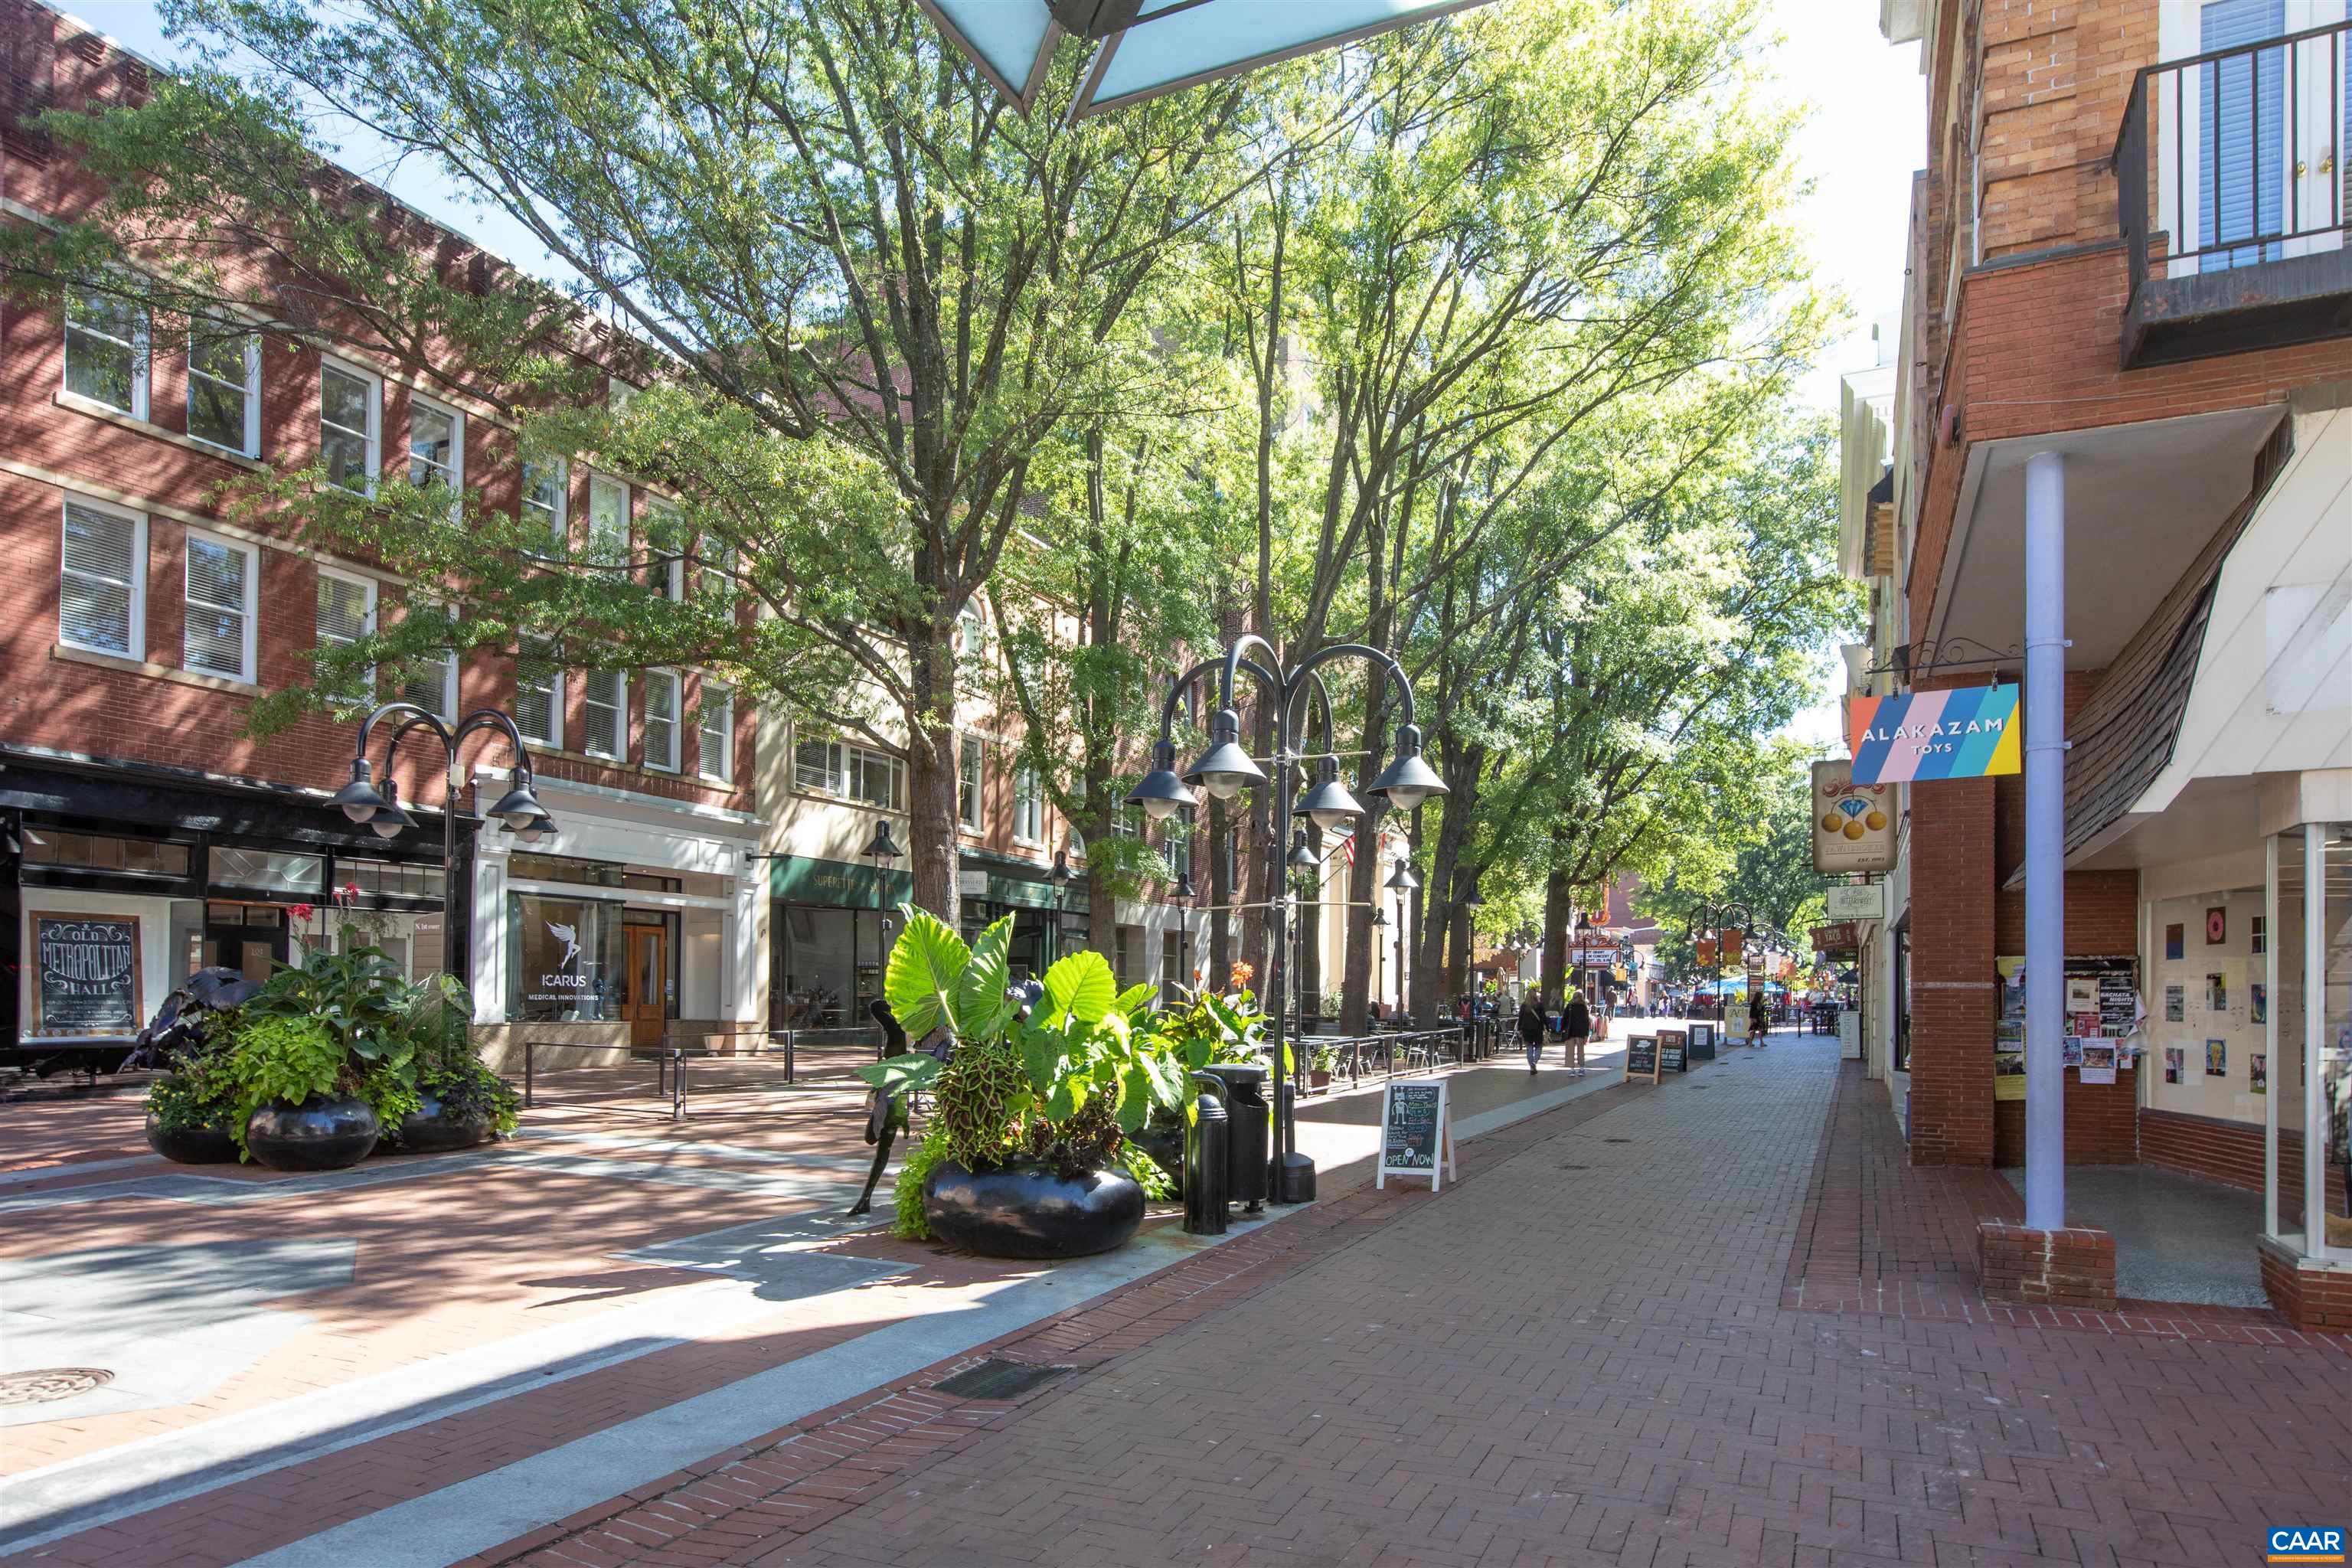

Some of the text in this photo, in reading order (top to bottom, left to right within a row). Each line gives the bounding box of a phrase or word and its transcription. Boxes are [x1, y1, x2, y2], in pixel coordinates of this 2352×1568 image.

[1861, 717, 2003, 742] ALAKAZAM
[1911, 743, 1952, 755] TOYS
[72, 930, 99, 942] OLD
[1825, 933, 1841, 944] TACO
[42, 942, 131, 981] METROPOLITAN
[542, 974, 586, 987] ICARUS
[70, 982, 112, 995] HALL
[1386, 1152, 1434, 1166] OPEN NOW
